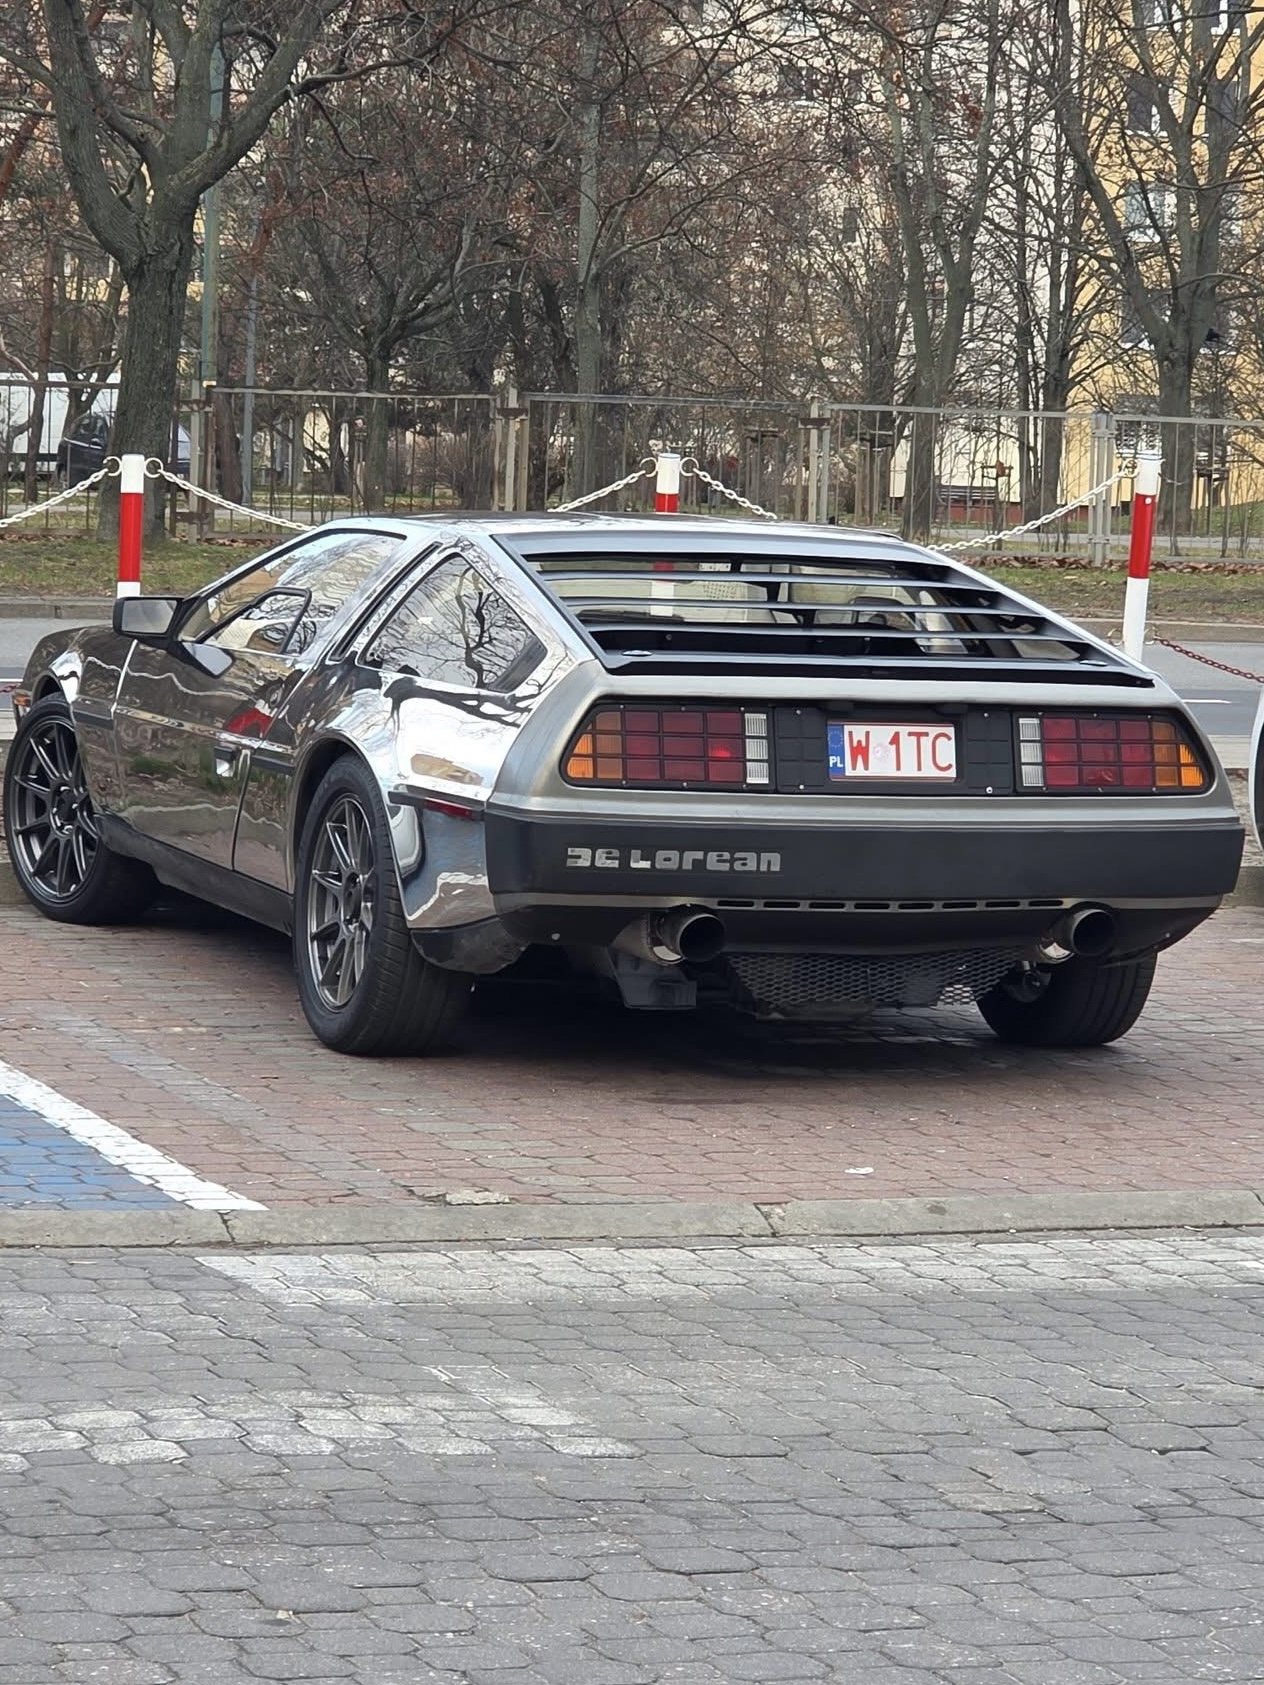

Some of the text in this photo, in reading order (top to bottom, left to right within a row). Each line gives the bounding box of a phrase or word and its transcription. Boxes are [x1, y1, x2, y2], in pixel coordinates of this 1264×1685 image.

[829, 756, 844, 768] PL
[848, 731, 953, 772] W 1TC
